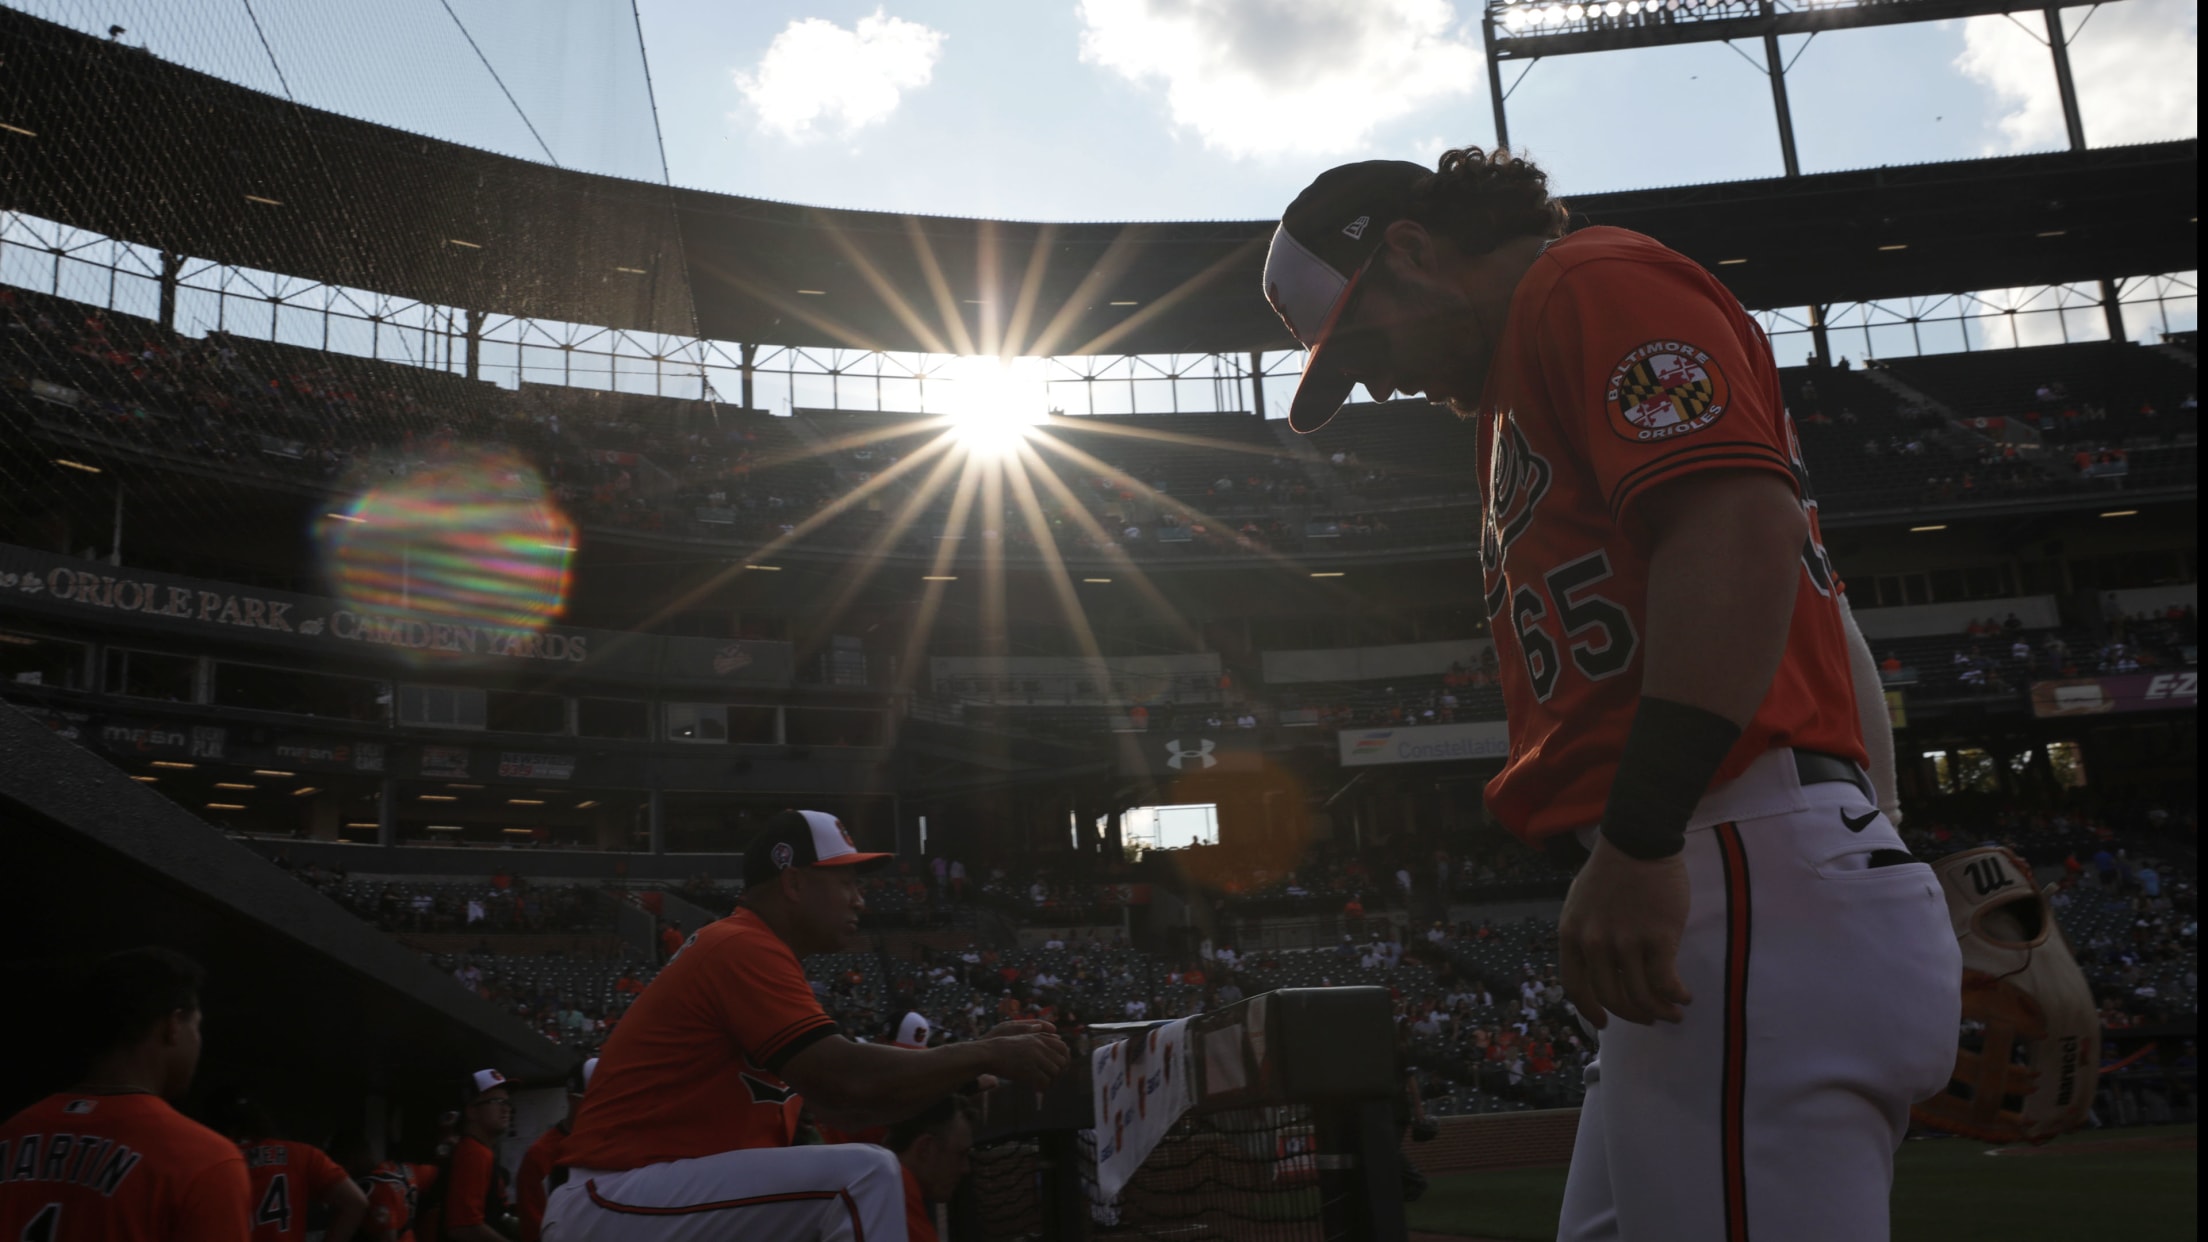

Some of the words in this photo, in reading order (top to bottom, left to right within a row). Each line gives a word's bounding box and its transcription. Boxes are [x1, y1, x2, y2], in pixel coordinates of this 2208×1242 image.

[1608, 341, 1709, 401] BALTIMORE
[1638, 404, 1722, 439] ORIOLES
[48, 567, 193, 619] ORIOLE
[197, 591, 294, 632] PARK
[330, 610, 477, 652] CAMDEN
[483, 626, 588, 662] YARDS
[1511, 547, 1640, 704] 65
[2055, 1035, 2078, 1106] marucci
[249, 1172, 293, 1233] 4
